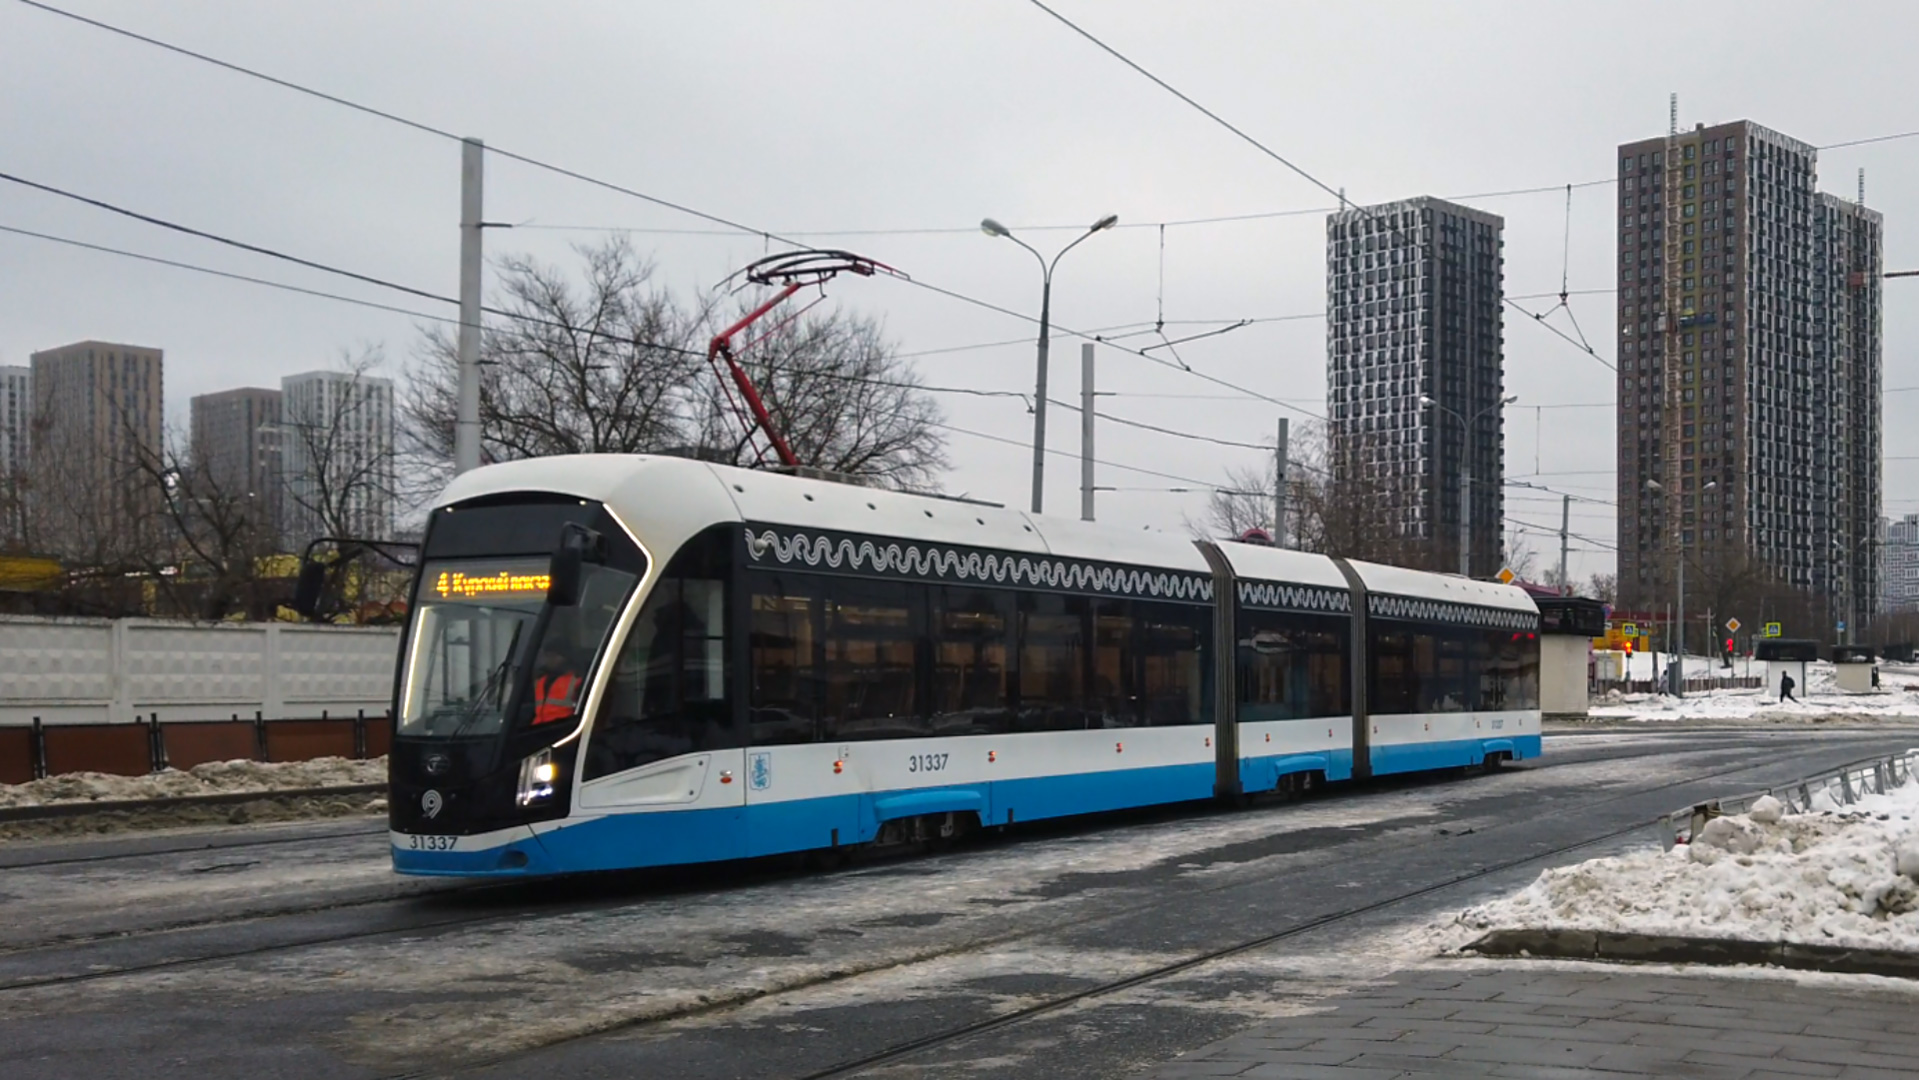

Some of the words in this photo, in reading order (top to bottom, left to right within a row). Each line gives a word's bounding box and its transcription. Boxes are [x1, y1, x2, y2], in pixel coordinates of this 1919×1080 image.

[436, 572, 449, 597] 4
[510, 575, 551, 591] вокза
[909, 753, 949, 772] 31337
[410, 835, 458, 850] 31337
